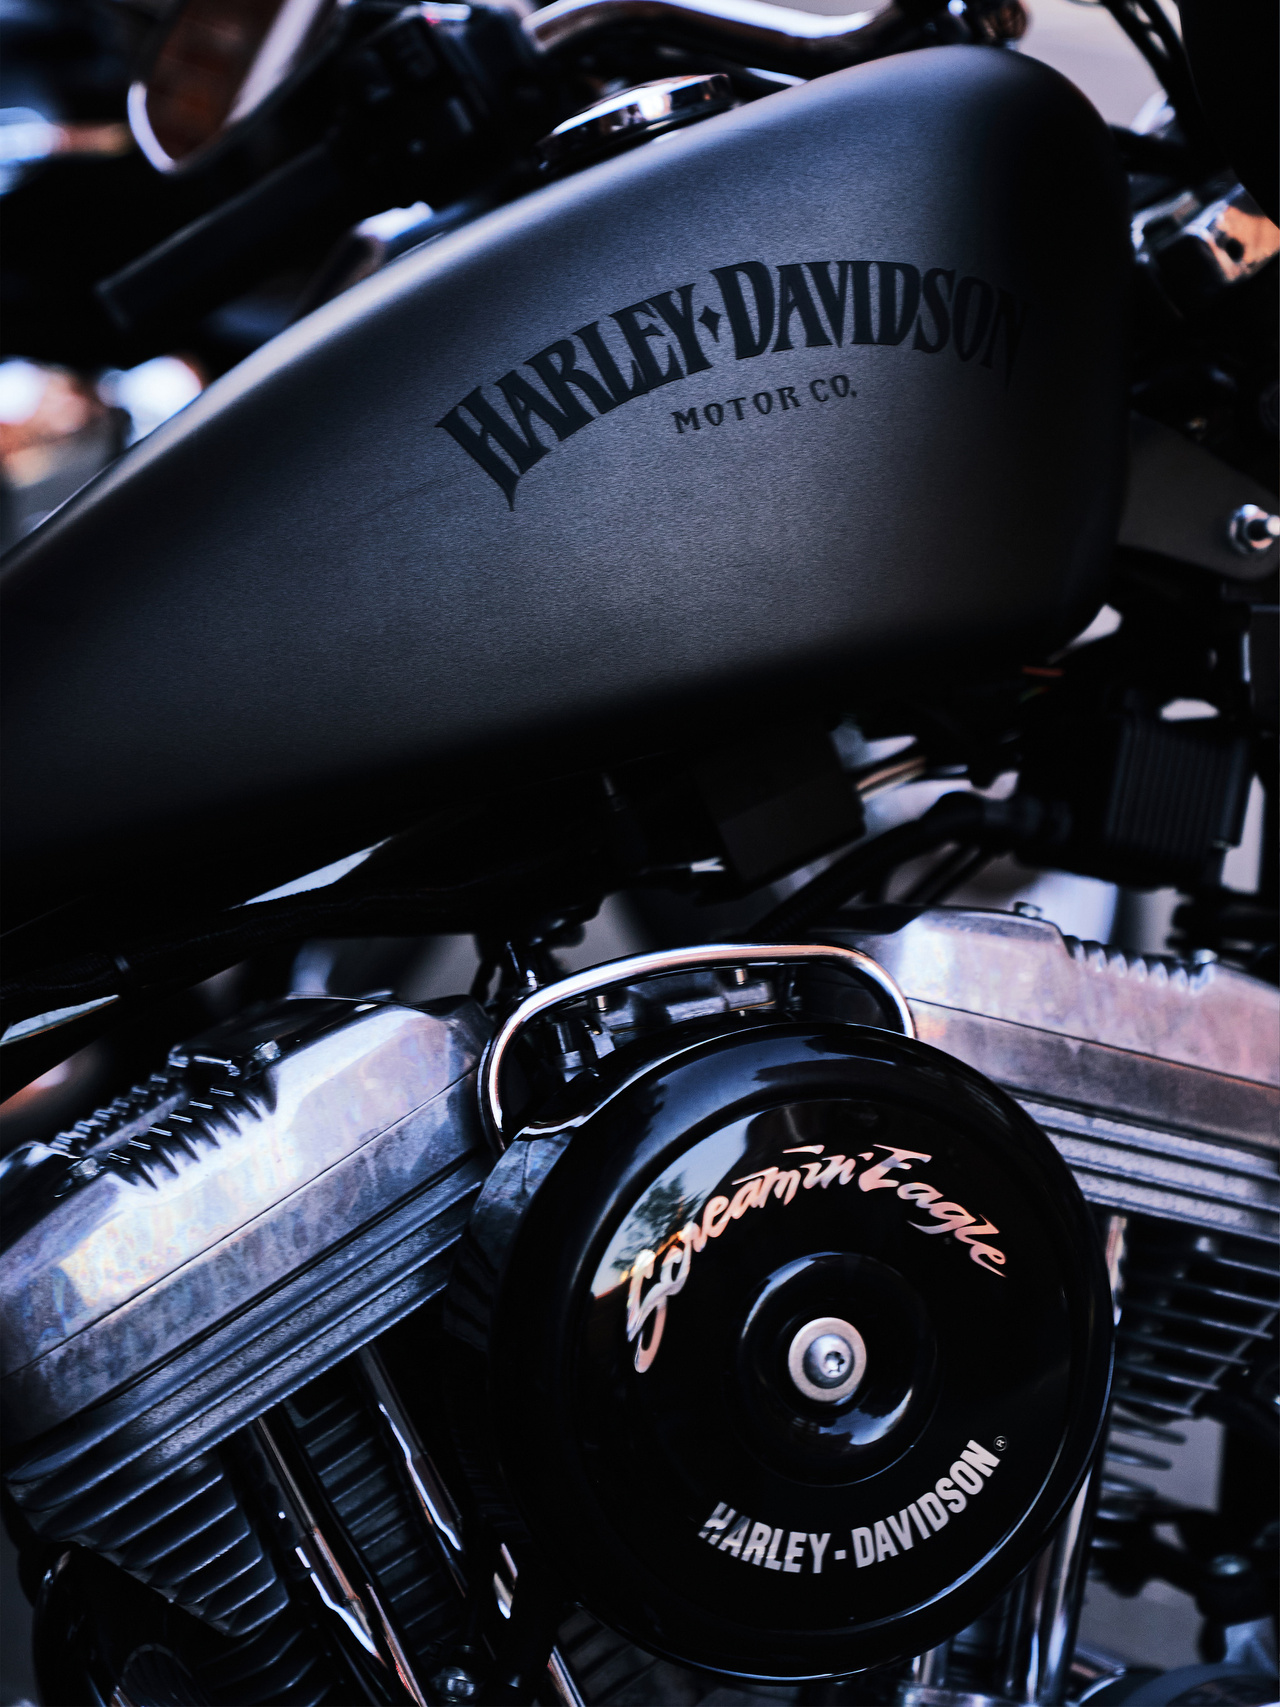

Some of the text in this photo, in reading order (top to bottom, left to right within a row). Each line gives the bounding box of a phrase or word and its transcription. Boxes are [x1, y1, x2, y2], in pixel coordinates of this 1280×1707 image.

[672, 373, 857, 434] MOTOR CO.
[858, 1144, 1007, 1277] Eagle
